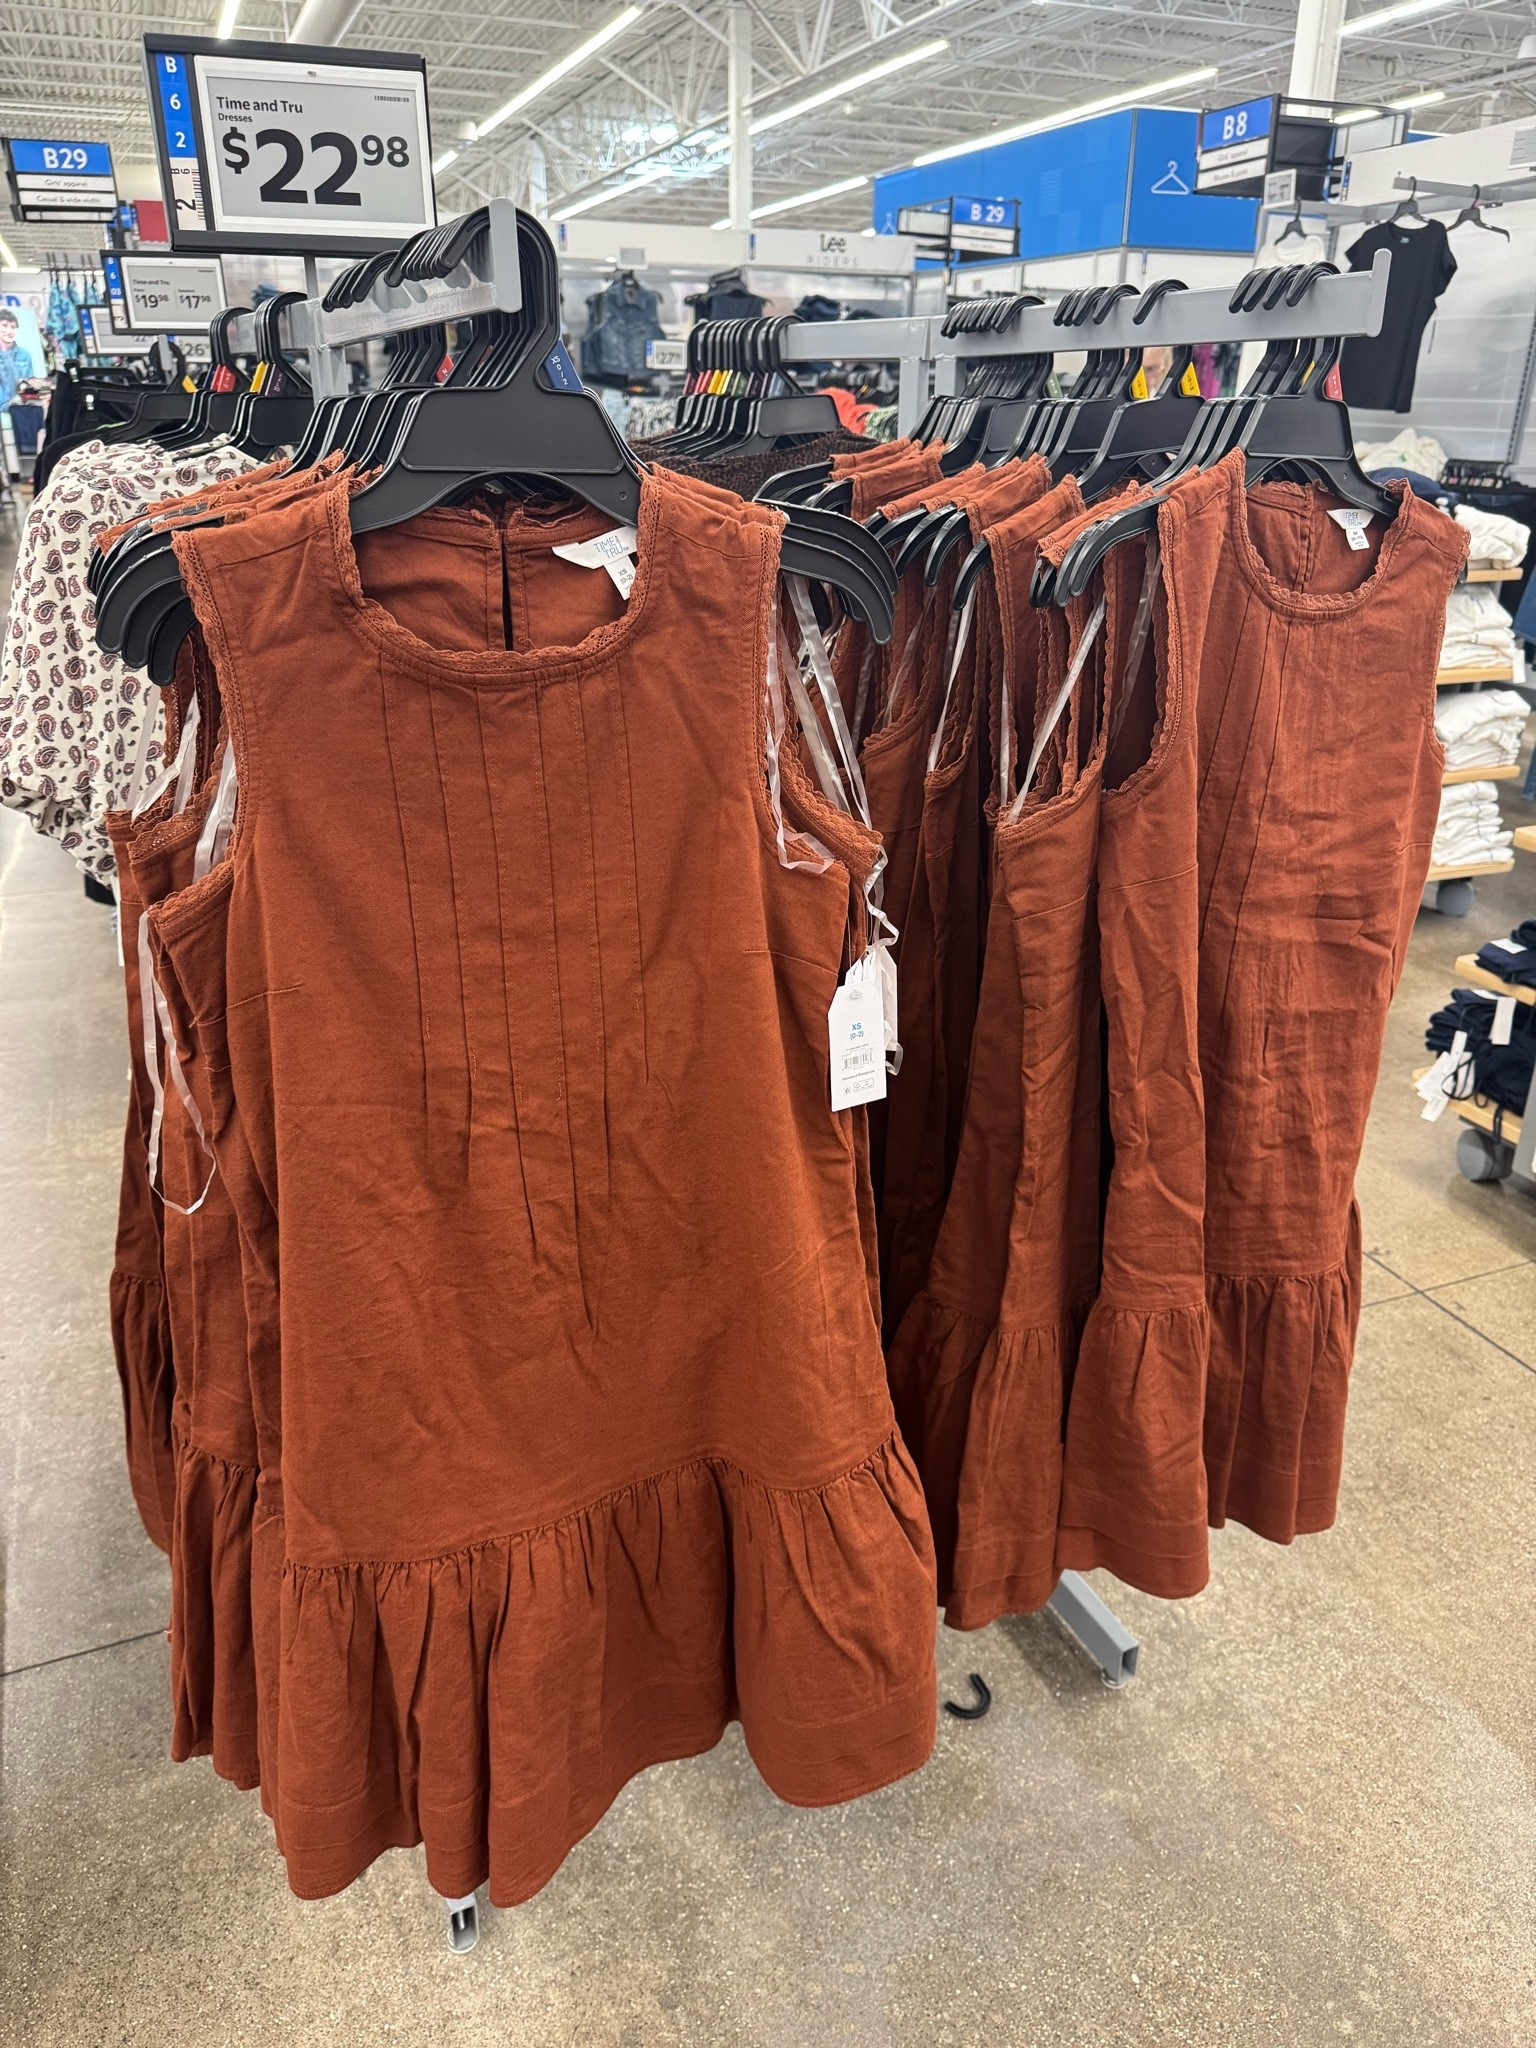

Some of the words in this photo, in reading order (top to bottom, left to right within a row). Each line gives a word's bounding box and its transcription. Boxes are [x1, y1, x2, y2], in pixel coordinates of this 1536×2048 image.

[165, 56, 177, 73] B
[170, 93, 181, 110] 6
[216, 96, 250, 110] Time
[253, 99, 278, 112] and
[280, 100, 303, 113] Tru
[218, 113, 253, 122] Dresses
[1223, 111, 1248, 140] B8
[175, 131, 187, 148] 2
[43, 147, 88, 170] B29
[970, 203, 982, 221] B
[985, 205, 1006, 223] 29
[820, 233, 847, 252] Lee
[593, 537, 616, 552] TIME
[603, 545, 624, 558] TRU
[618, 568, 628, 577] XS
[850, 1030, 864, 1040] (0-2)
[851, 1022, 862, 1031] XS
